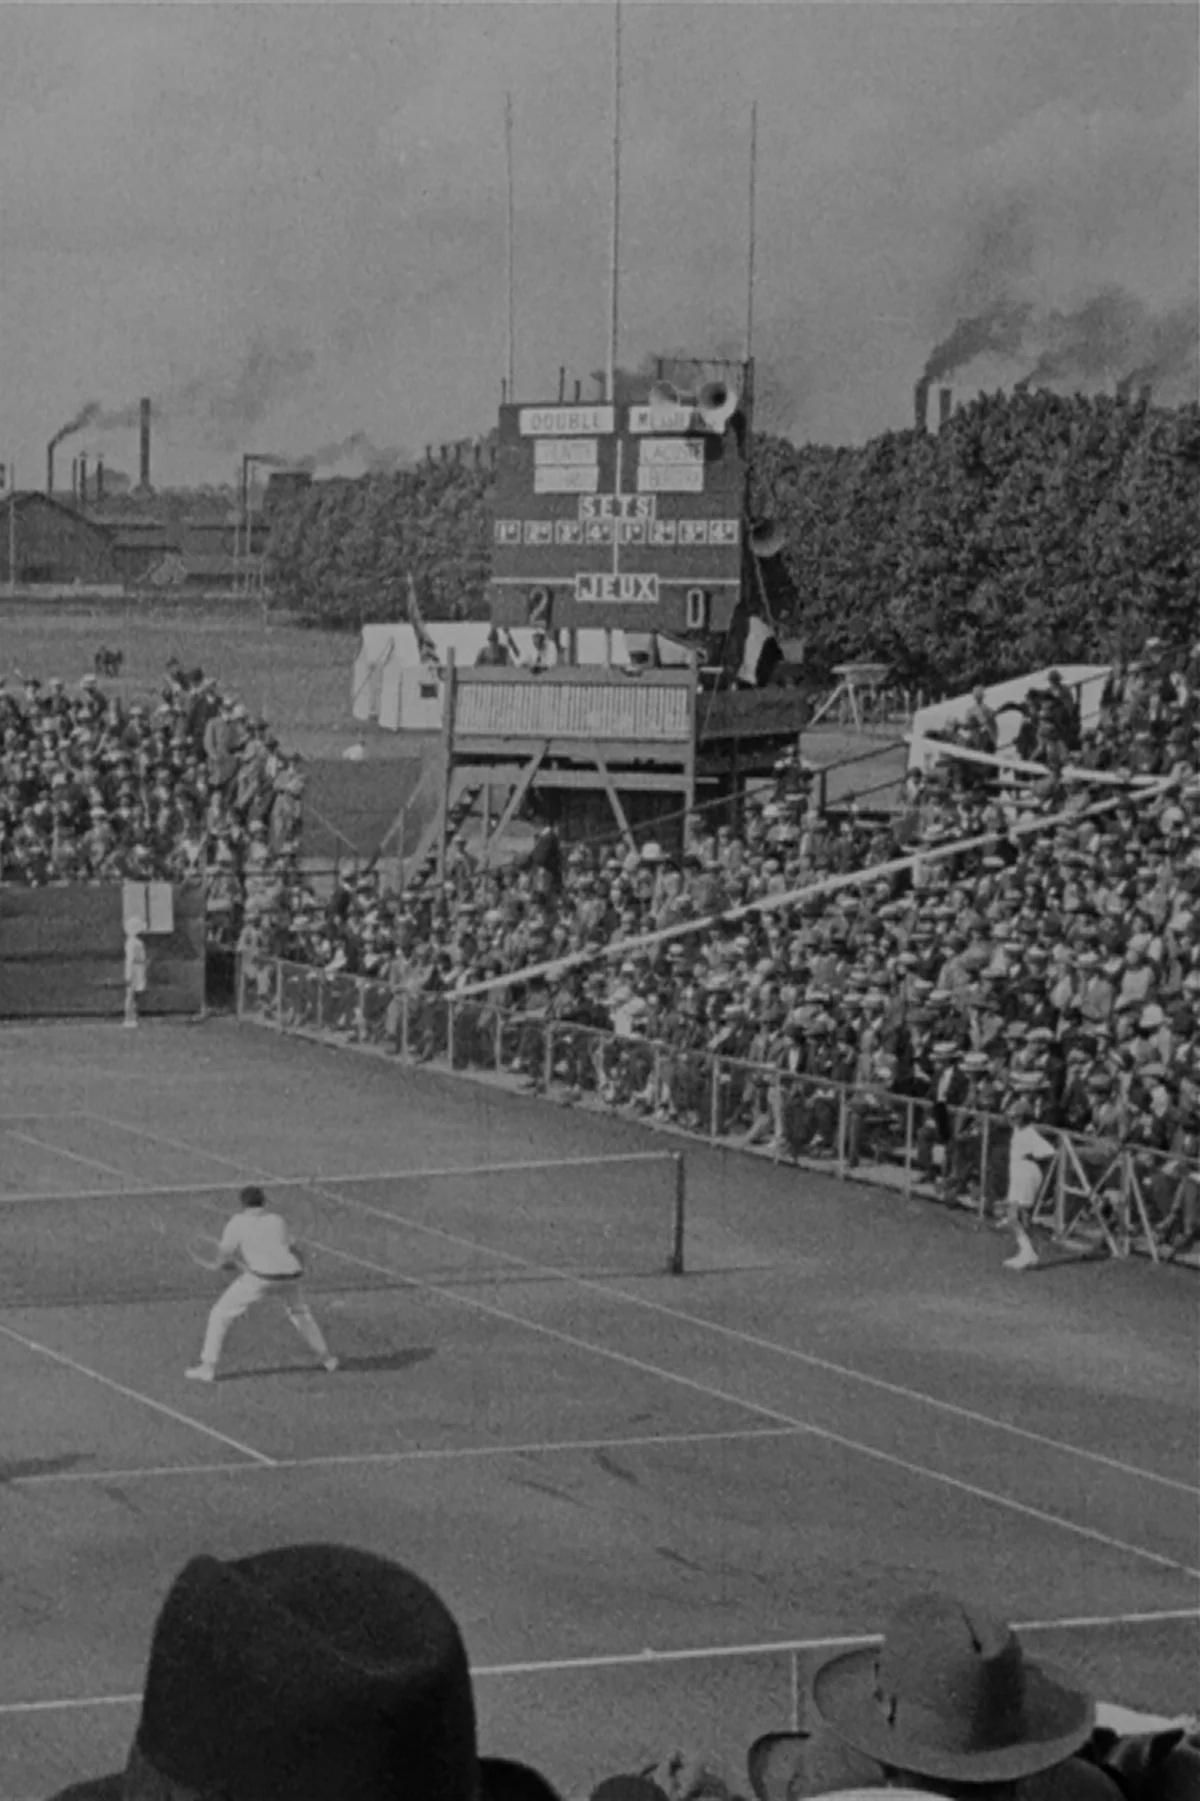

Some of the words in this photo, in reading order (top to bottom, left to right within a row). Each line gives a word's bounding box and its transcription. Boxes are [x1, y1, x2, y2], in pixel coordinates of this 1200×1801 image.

[580, 498, 649, 518] SETS
[579, 576, 651, 598] JEUX
[529, 588, 548, 627] 2
